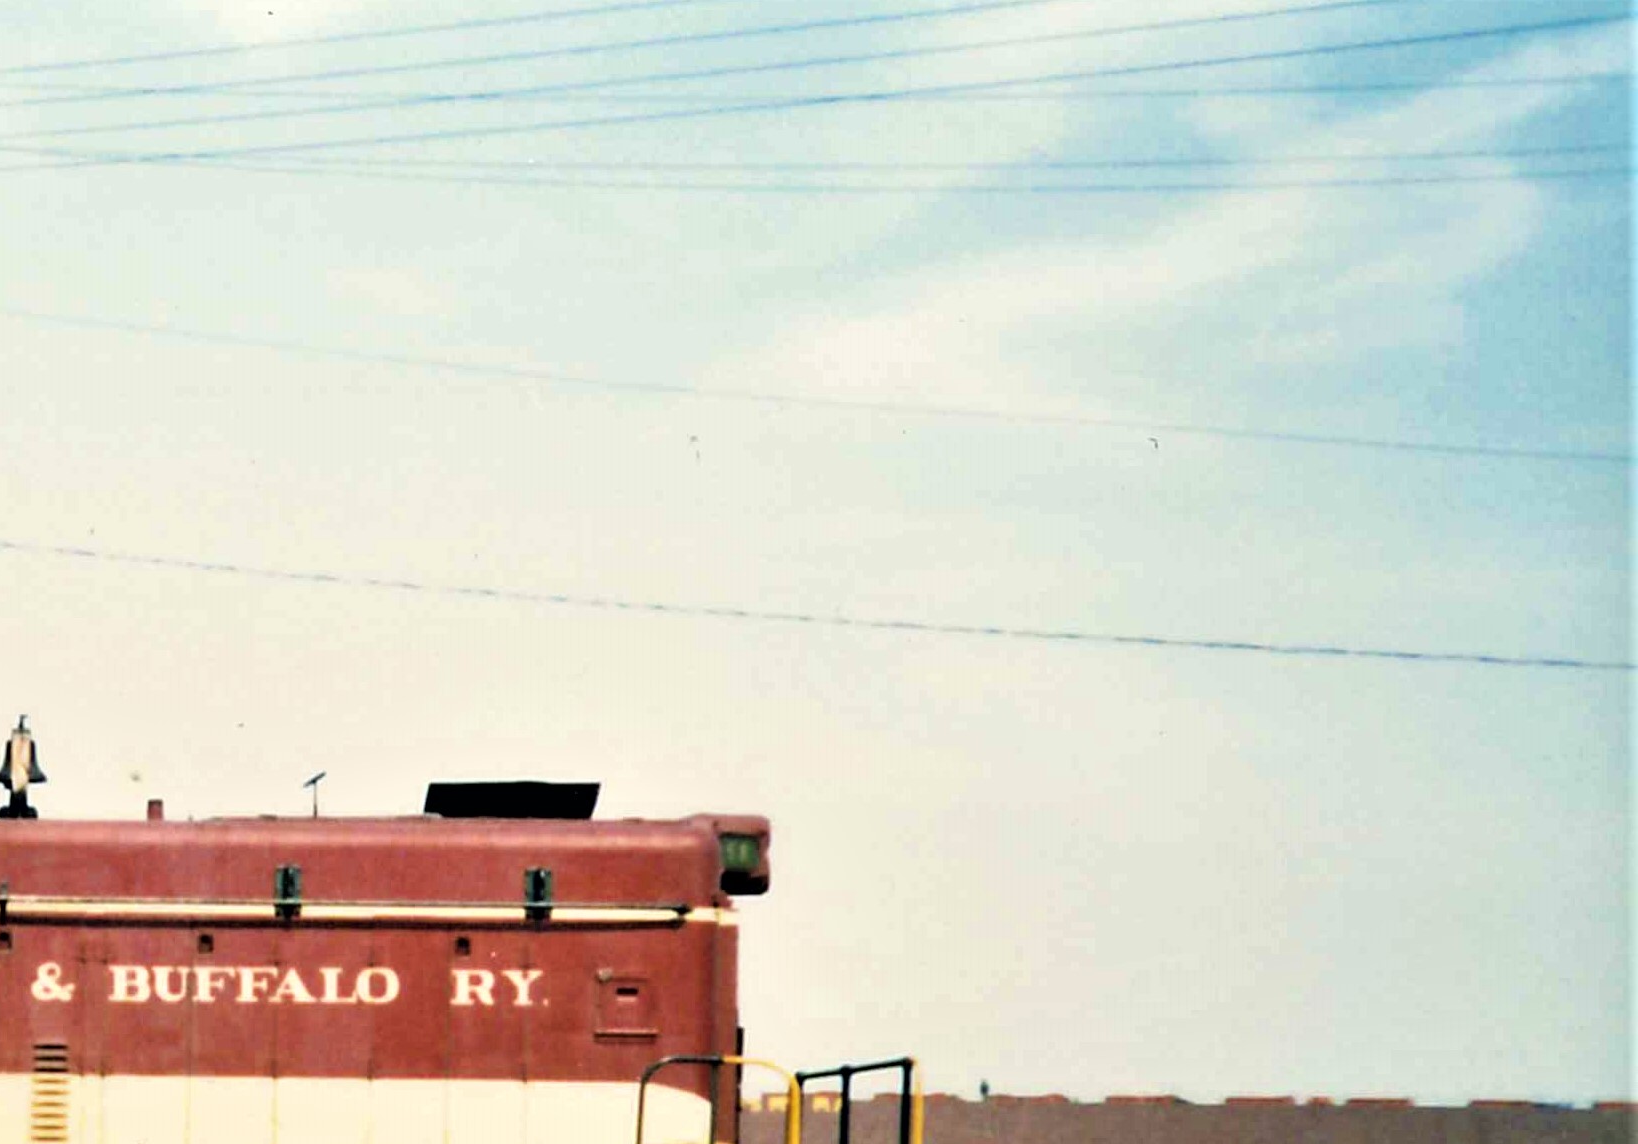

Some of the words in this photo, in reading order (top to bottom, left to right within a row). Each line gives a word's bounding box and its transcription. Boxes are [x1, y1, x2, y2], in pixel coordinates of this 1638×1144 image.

[30, 962, 75, 1002] &
[108, 963, 401, 1005] BUFFALO
[451, 968, 549, 1006] RY.
